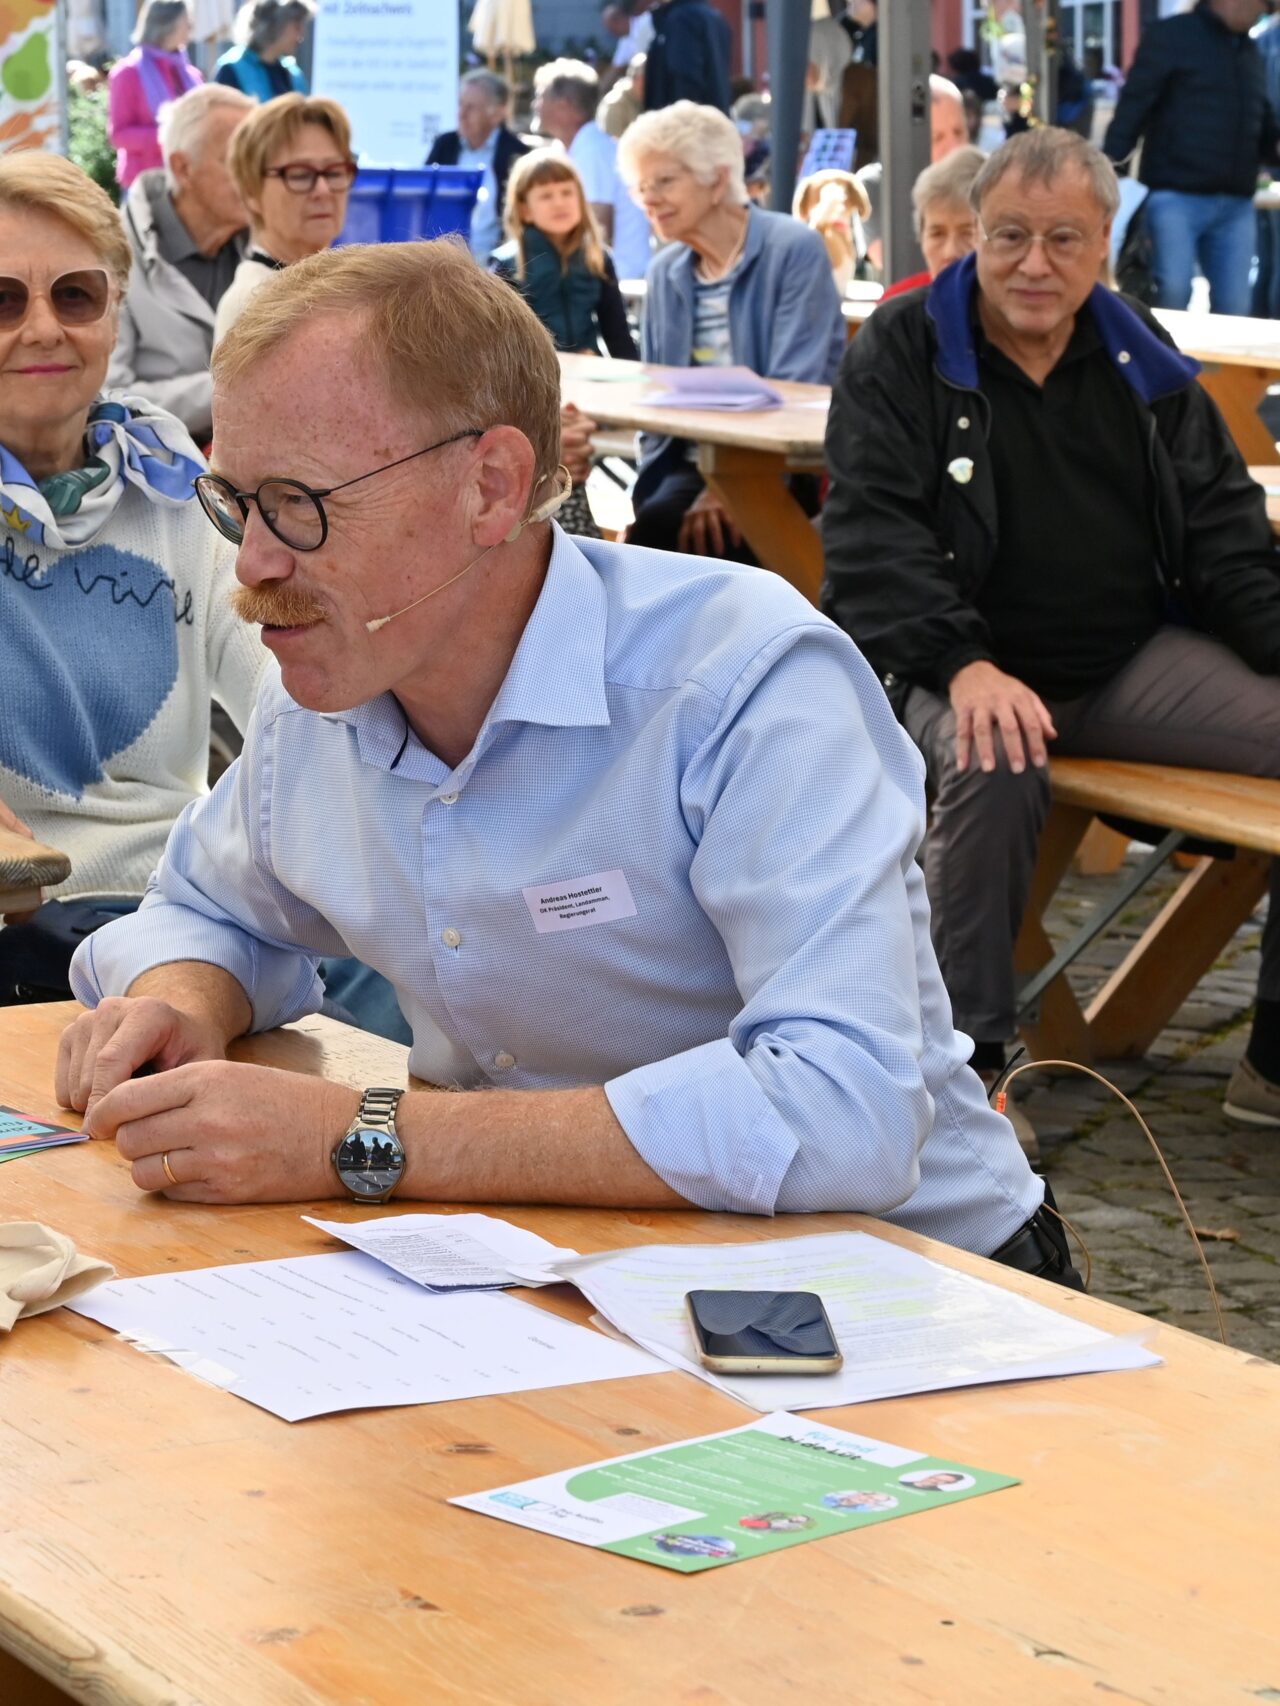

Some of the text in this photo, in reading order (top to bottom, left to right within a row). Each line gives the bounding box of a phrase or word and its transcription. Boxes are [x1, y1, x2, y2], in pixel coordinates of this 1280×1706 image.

[540, 886, 602, 904] Andreas Hostettler
[559, 907, 596, 919] Regierungsrat
